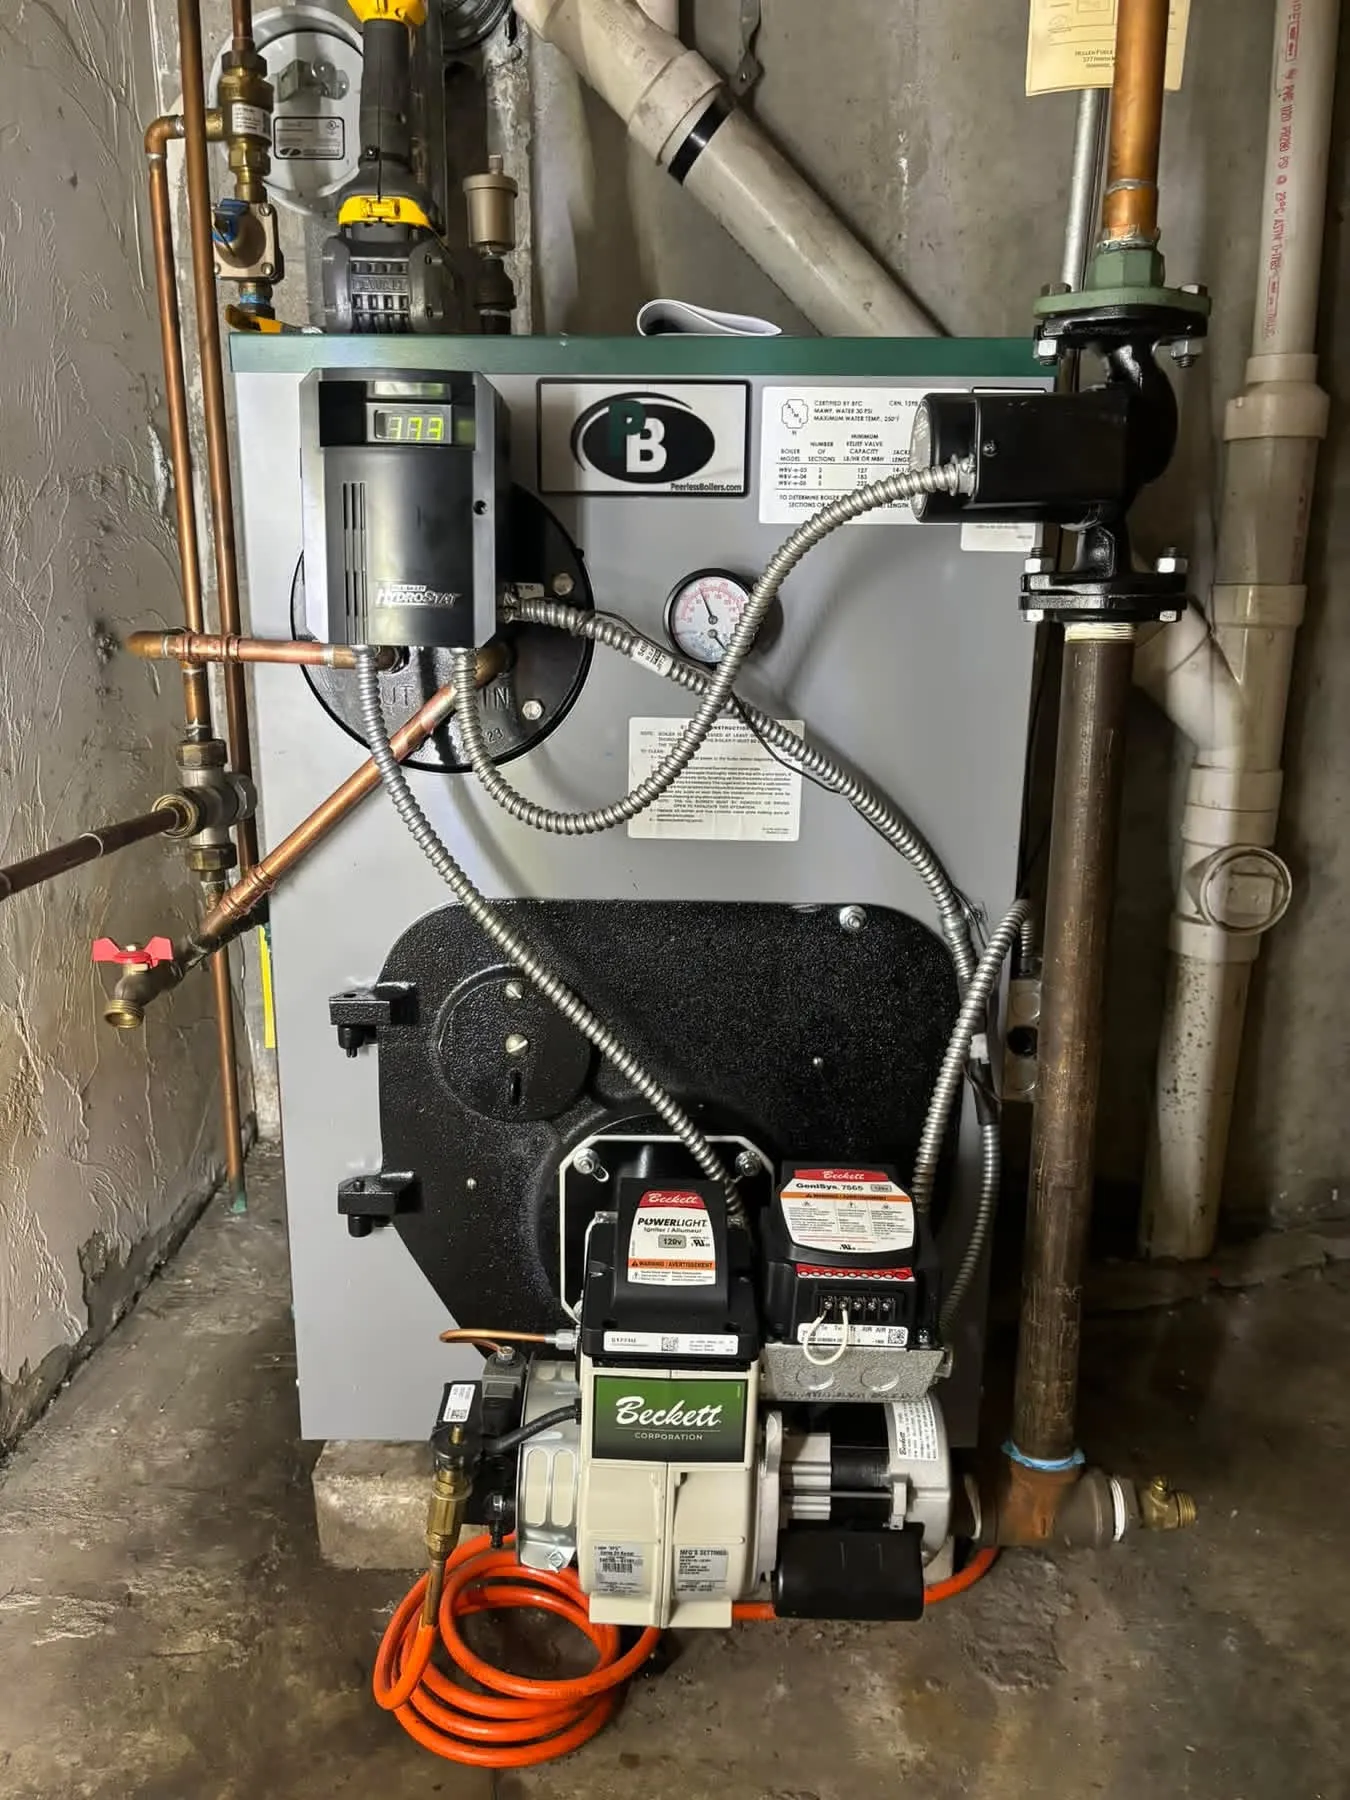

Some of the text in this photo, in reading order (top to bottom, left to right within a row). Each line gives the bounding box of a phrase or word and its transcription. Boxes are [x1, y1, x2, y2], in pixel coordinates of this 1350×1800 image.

[670, 482, 742, 491] PeerlessBoilers.com
[822, 1170, 865, 1180] Beckett
[648, 1192, 697, 1205] Beckett
[638, 1217, 708, 1228] POWERLIGHT
[615, 1396, 722, 1427] Beckett
[634, 1432, 703, 1441] CORPORATION
